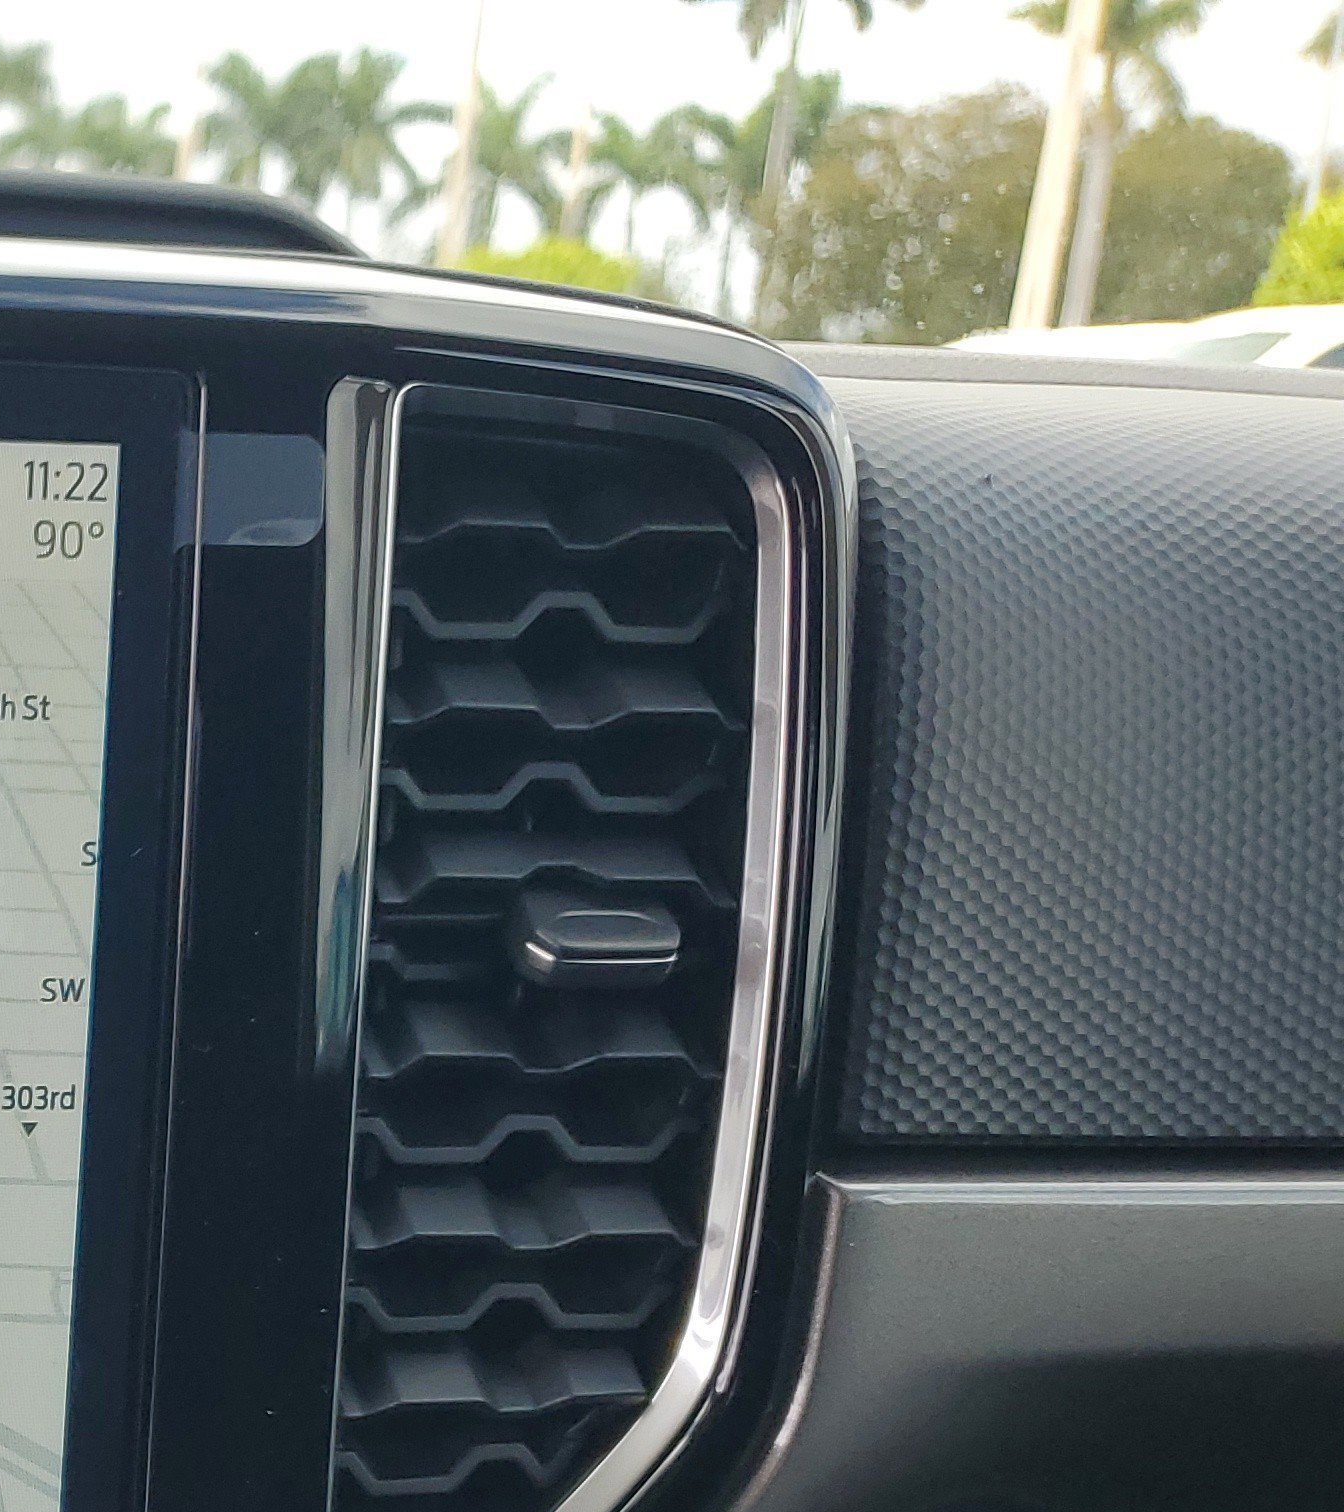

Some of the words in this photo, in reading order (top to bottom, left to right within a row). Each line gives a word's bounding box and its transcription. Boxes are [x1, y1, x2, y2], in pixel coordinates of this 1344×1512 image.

[24, 460, 109, 503] 11:22
[34, 520, 104, 559] 90°
[22, 694, 51, 721] St
[40, 978, 86, 1003] SW
[1, 1083, 76, 1111] 303rd
